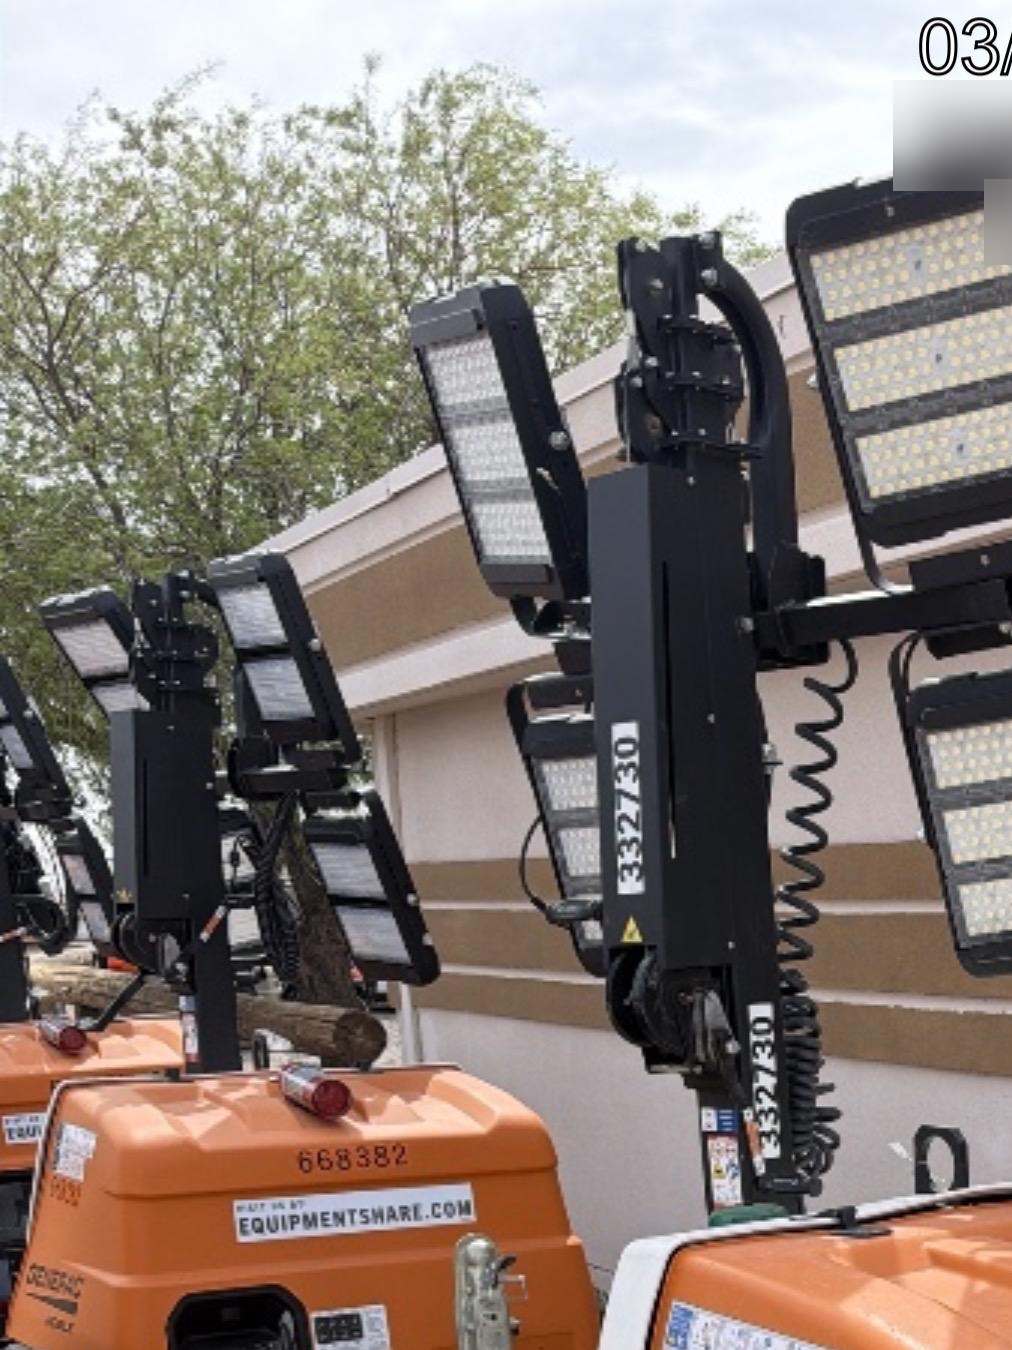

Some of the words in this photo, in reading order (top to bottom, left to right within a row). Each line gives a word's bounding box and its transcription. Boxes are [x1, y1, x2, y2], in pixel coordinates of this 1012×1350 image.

[614, 737, 644, 883] 332730
[751, 1016, 779, 1148] 332730
[298, 1143, 408, 1174] 668382
[238, 1199, 472, 1237] EQUIPMENTSHARE.COM
